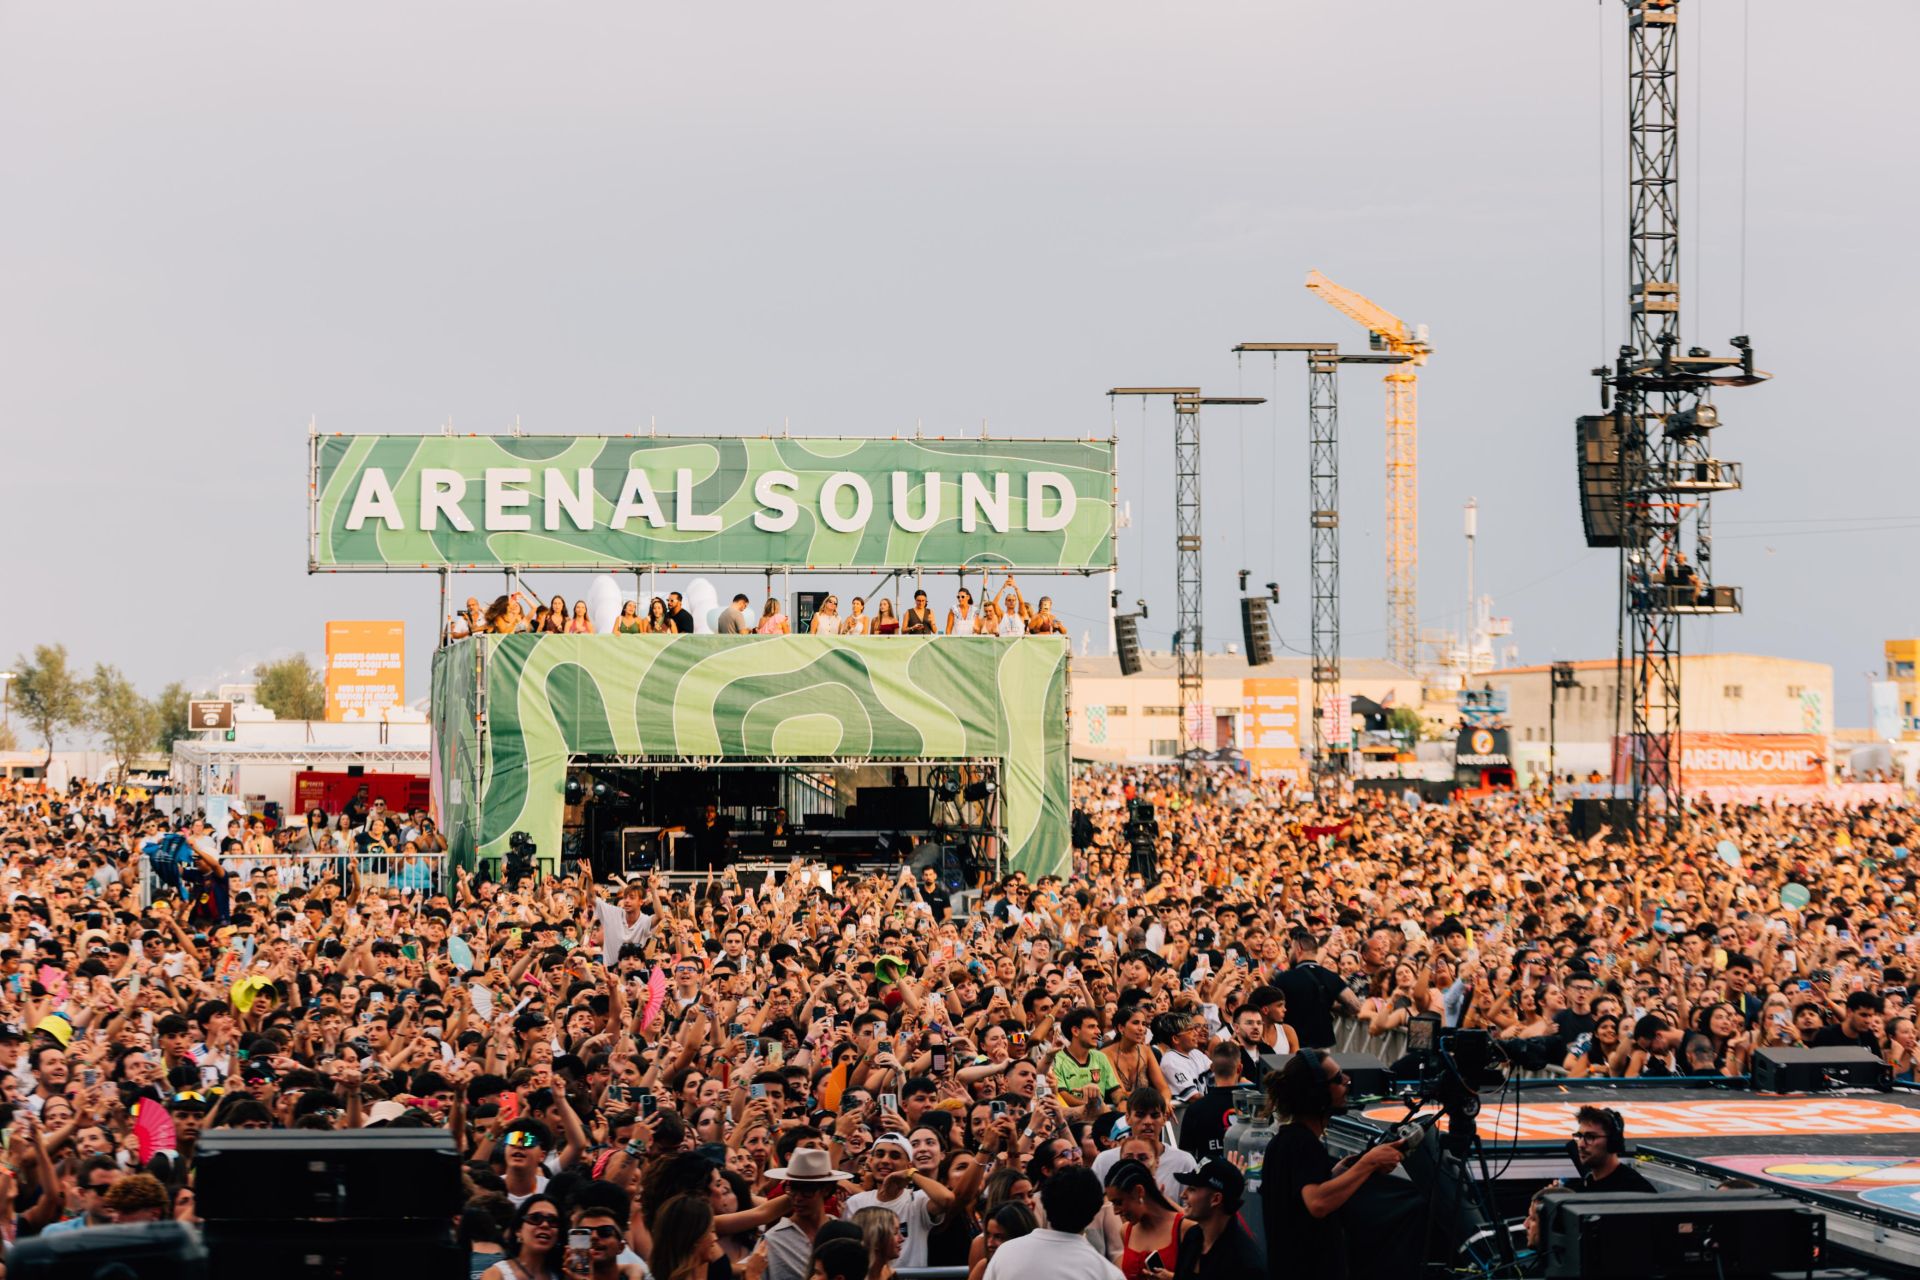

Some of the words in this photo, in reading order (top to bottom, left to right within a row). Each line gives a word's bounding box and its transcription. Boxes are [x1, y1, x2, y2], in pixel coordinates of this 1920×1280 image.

[344, 467, 723, 532] ARENAL
[753, 470, 1077, 532] SOUND
[1457, 753, 1509, 765] NEGRITA
